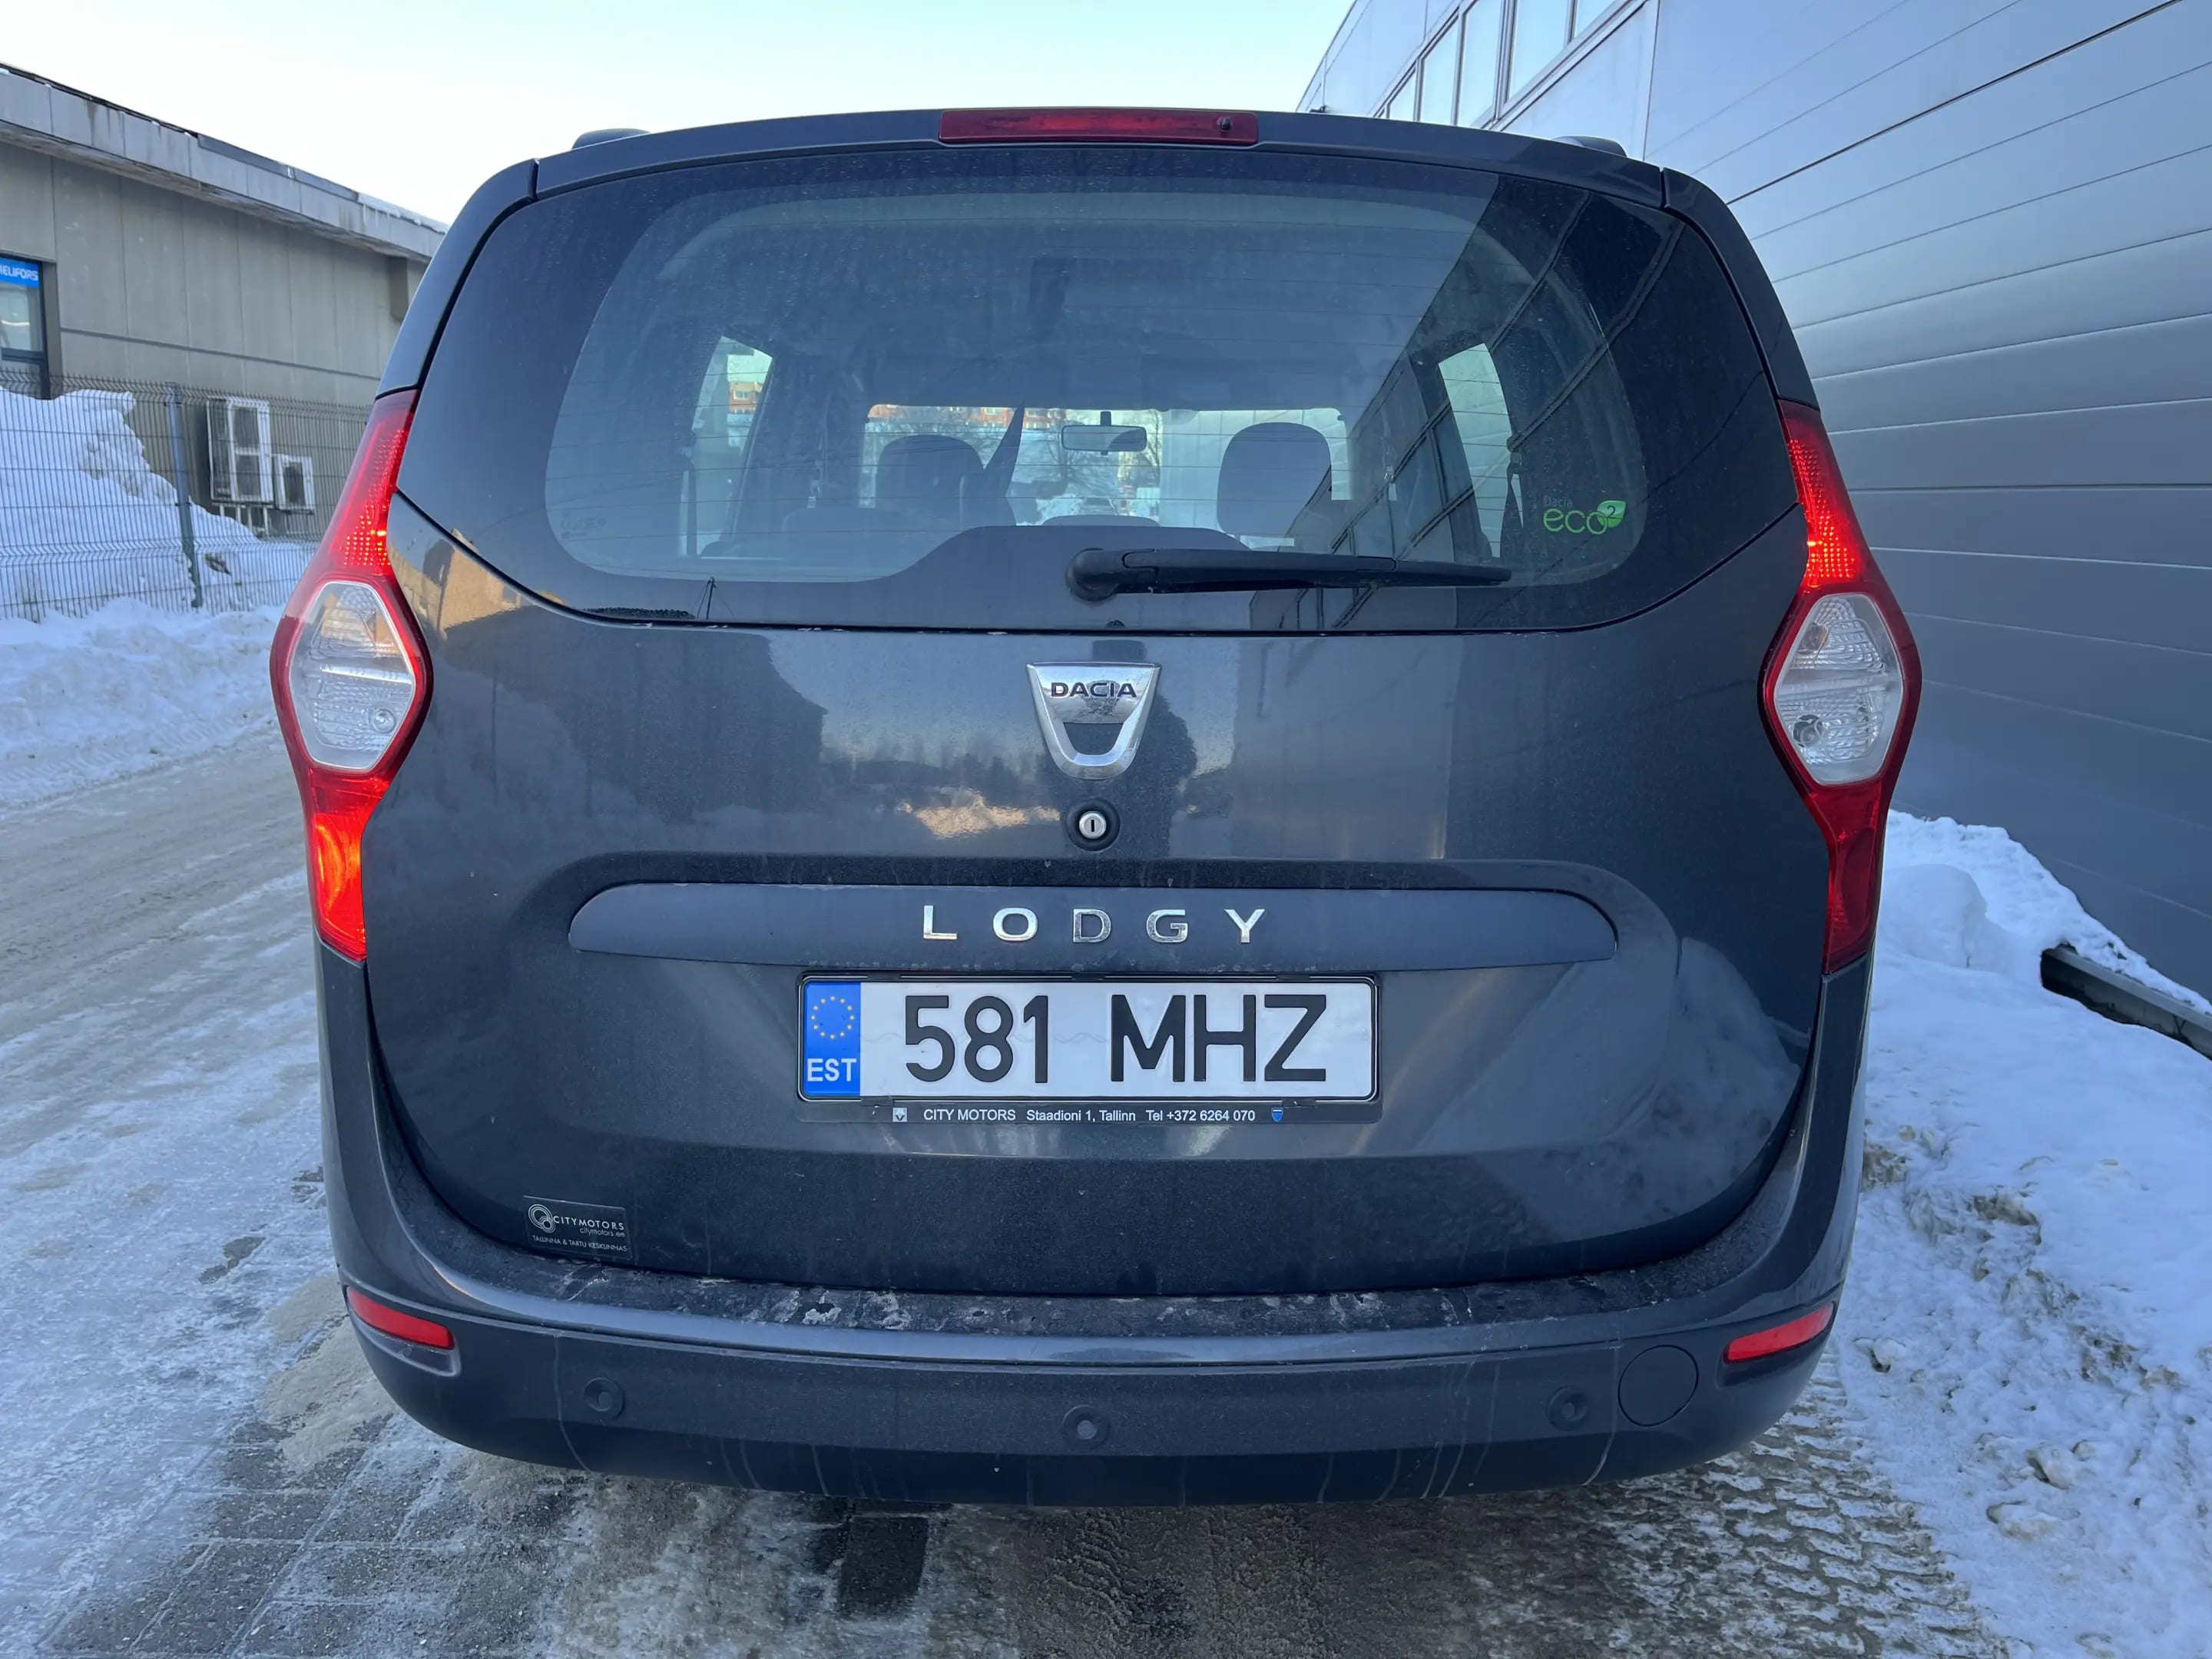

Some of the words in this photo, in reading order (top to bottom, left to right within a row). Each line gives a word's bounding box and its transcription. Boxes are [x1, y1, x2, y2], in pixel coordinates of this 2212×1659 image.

[1544, 495, 1572, 507] Dacia
[1051, 681, 1137, 698] DACIA
[922, 904, 1265, 943] LODGY
[905, 995, 1049, 1083] 581
[1111, 994, 1327, 1082] MHZ
[807, 1058, 857, 1081] EST
[923, 1109, 954, 1121] CITY
[957, 1109, 1016, 1121] MOTORS
[1026, 1109, 1082, 1121] Staadioni
[1086, 1110, 1095, 1122] 1,
[1099, 1110, 1136, 1121] Tallinn
[1146, 1110, 1163, 1121] Tel
[1166, 1110, 1197, 1121] +372
[1200, 1110, 1230, 1121] 6264
[1233, 1110, 1256, 1121] 070
[580, 1227, 625, 1237] citymotors.ee
[569, 1239, 587, 1247] TARTU
